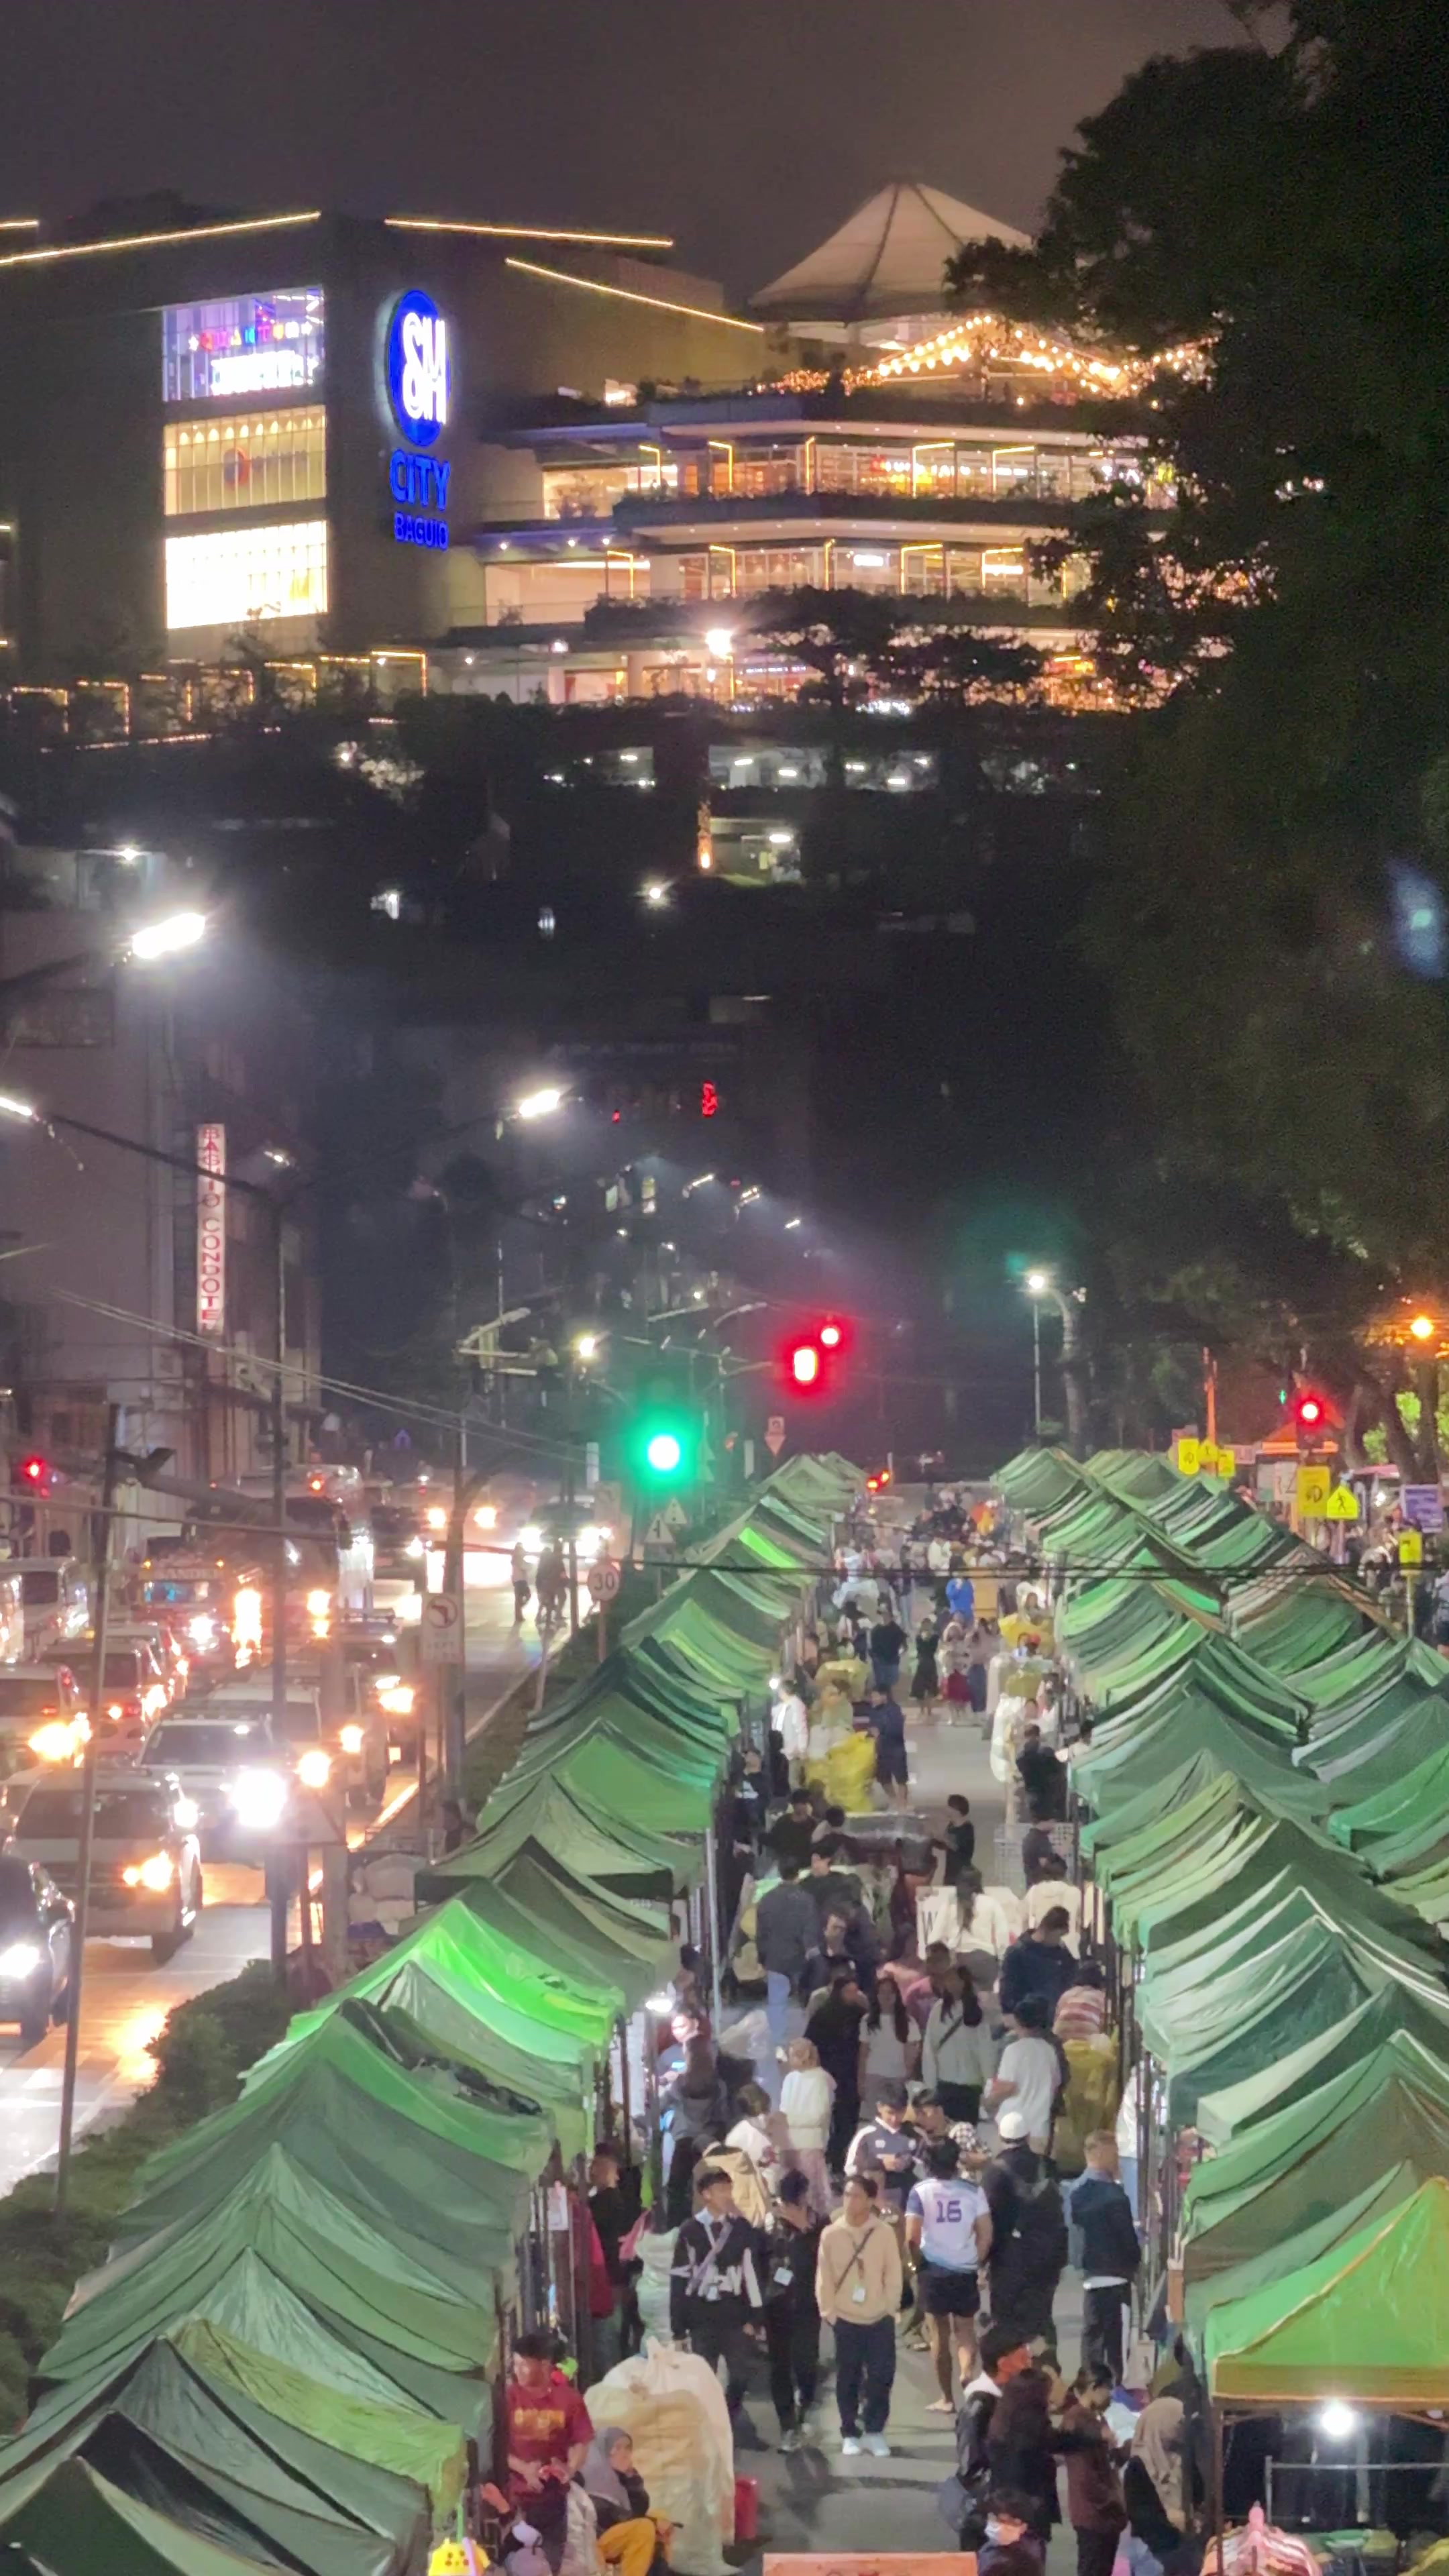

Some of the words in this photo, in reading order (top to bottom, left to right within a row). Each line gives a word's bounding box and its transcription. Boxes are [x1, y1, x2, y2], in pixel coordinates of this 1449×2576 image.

[403, 312, 446, 425] SM
[390, 449, 450, 511] CITY
[394, 512, 448, 549] BAGUIO
[594, 1571, 615, 1591] 30
[936, 2200, 962, 2222] 16
